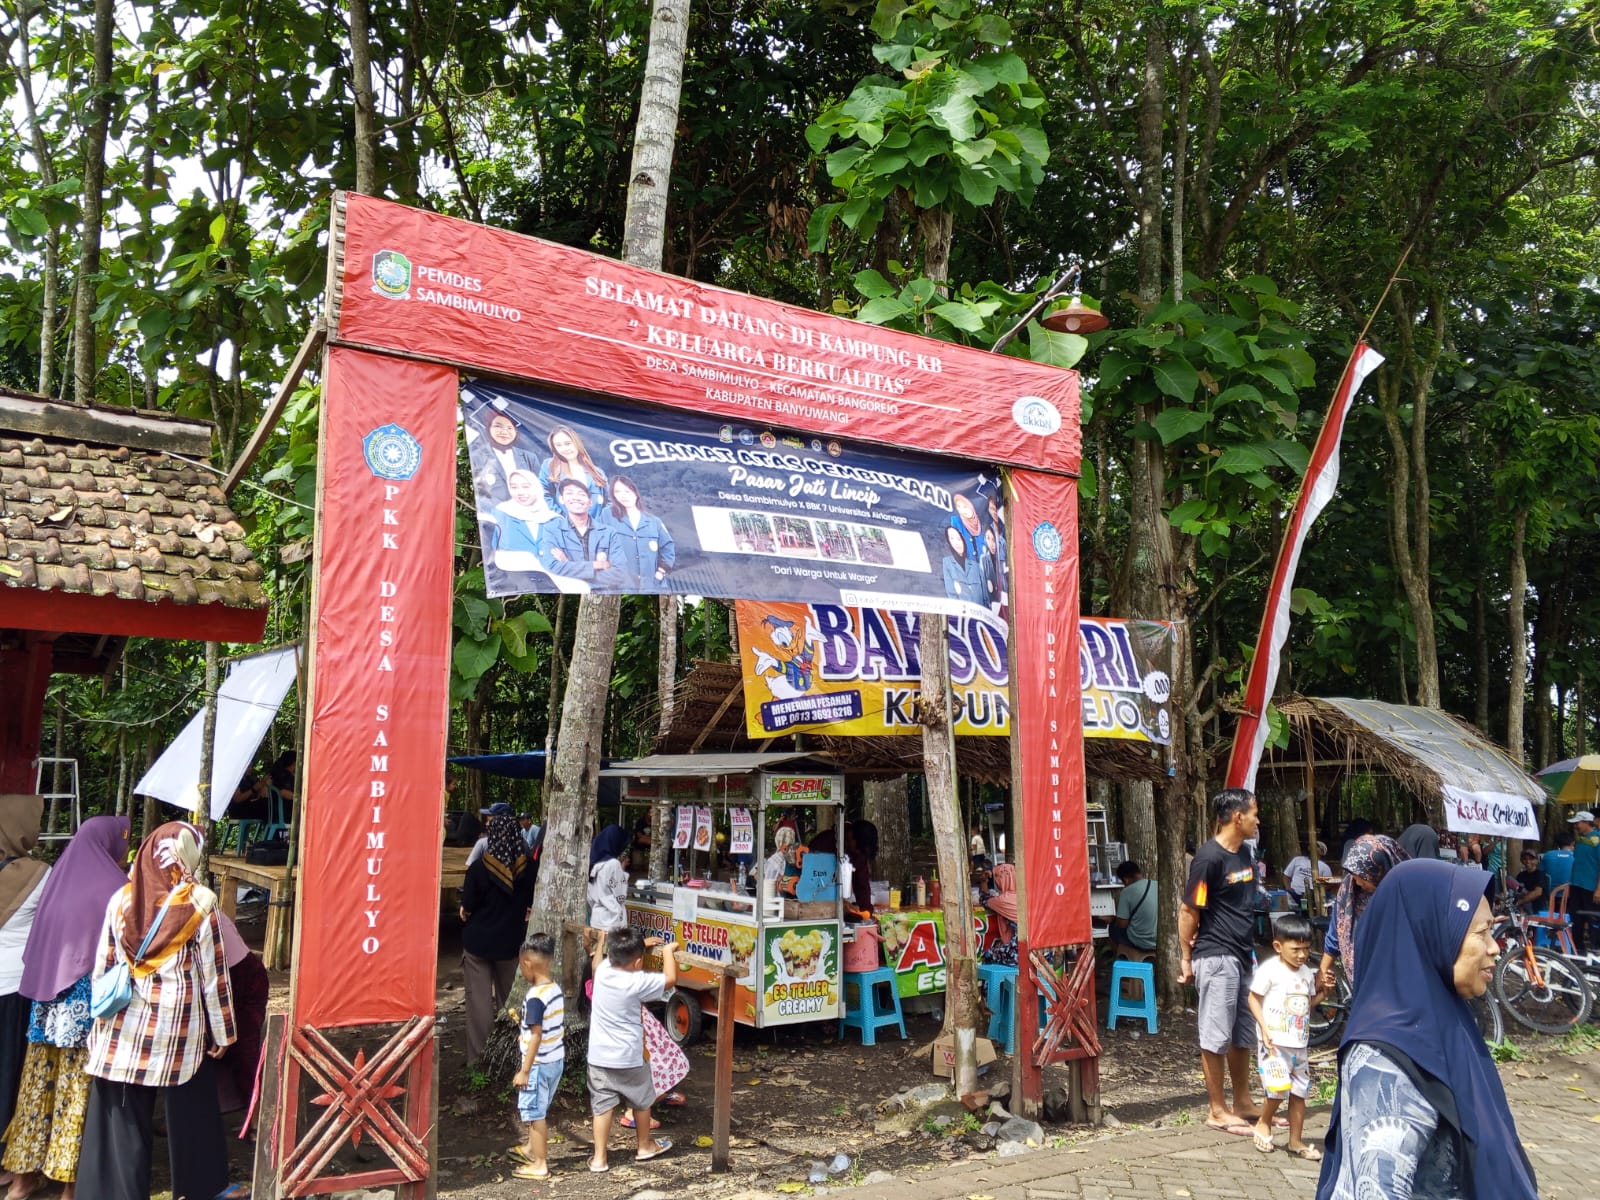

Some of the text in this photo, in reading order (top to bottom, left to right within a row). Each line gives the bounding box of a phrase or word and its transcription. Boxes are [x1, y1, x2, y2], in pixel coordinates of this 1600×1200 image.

[417, 265, 482, 292] PEMDES
[416, 287, 521, 322] SAMBIMULYO
[585, 276, 942, 373] SELAMAT DATANG DI KAMPUNG KB
[646, 324, 766, 368] KELUARGA
[646, 355, 678, 373] DESA
[681, 363, 759, 389] SAMBIMULYO
[769, 381, 836, 405] KECAMATAN
[838, 395, 899, 416] BANGOREJO
[705, 387, 849, 424] KABUPATEN BANYUWANGI
[610, 439, 954, 513] SELAMAT ATAS PEMBUKAAN
[728, 466, 881, 508] Pasar Jati Lincip
[382, 484, 400, 550] PKK
[718, 491, 742, 502] Desa
[743, 494, 798, 511] Sambimulyo
[828, 504, 871, 519] Universitas
[872, 510, 908, 525] Airlangga
[794, 567, 822, 580] Warga
[823, 570, 847, 581] Untuk
[1044, 564, 1055, 611] PKK
[377, 581, 397, 672] DESA
[1046, 632, 1056, 698] DESA
[771, 694, 853, 716] MENERIMA PESANAN
[773, 715, 789, 728] HP.
[811, 708, 832, 721] 3692
[775, 777, 823, 793] ASRI
[1050, 719, 1065, 897] SAMBIMULYO
[362, 704, 389, 954] SAMBIMULYO
[629, 909, 673, 932] ENTOL
[682, 921, 728, 948] ES TELLER
[773, 980, 829, 1001] ES TELLER
[779, 997, 823, 1016] CREAMY
